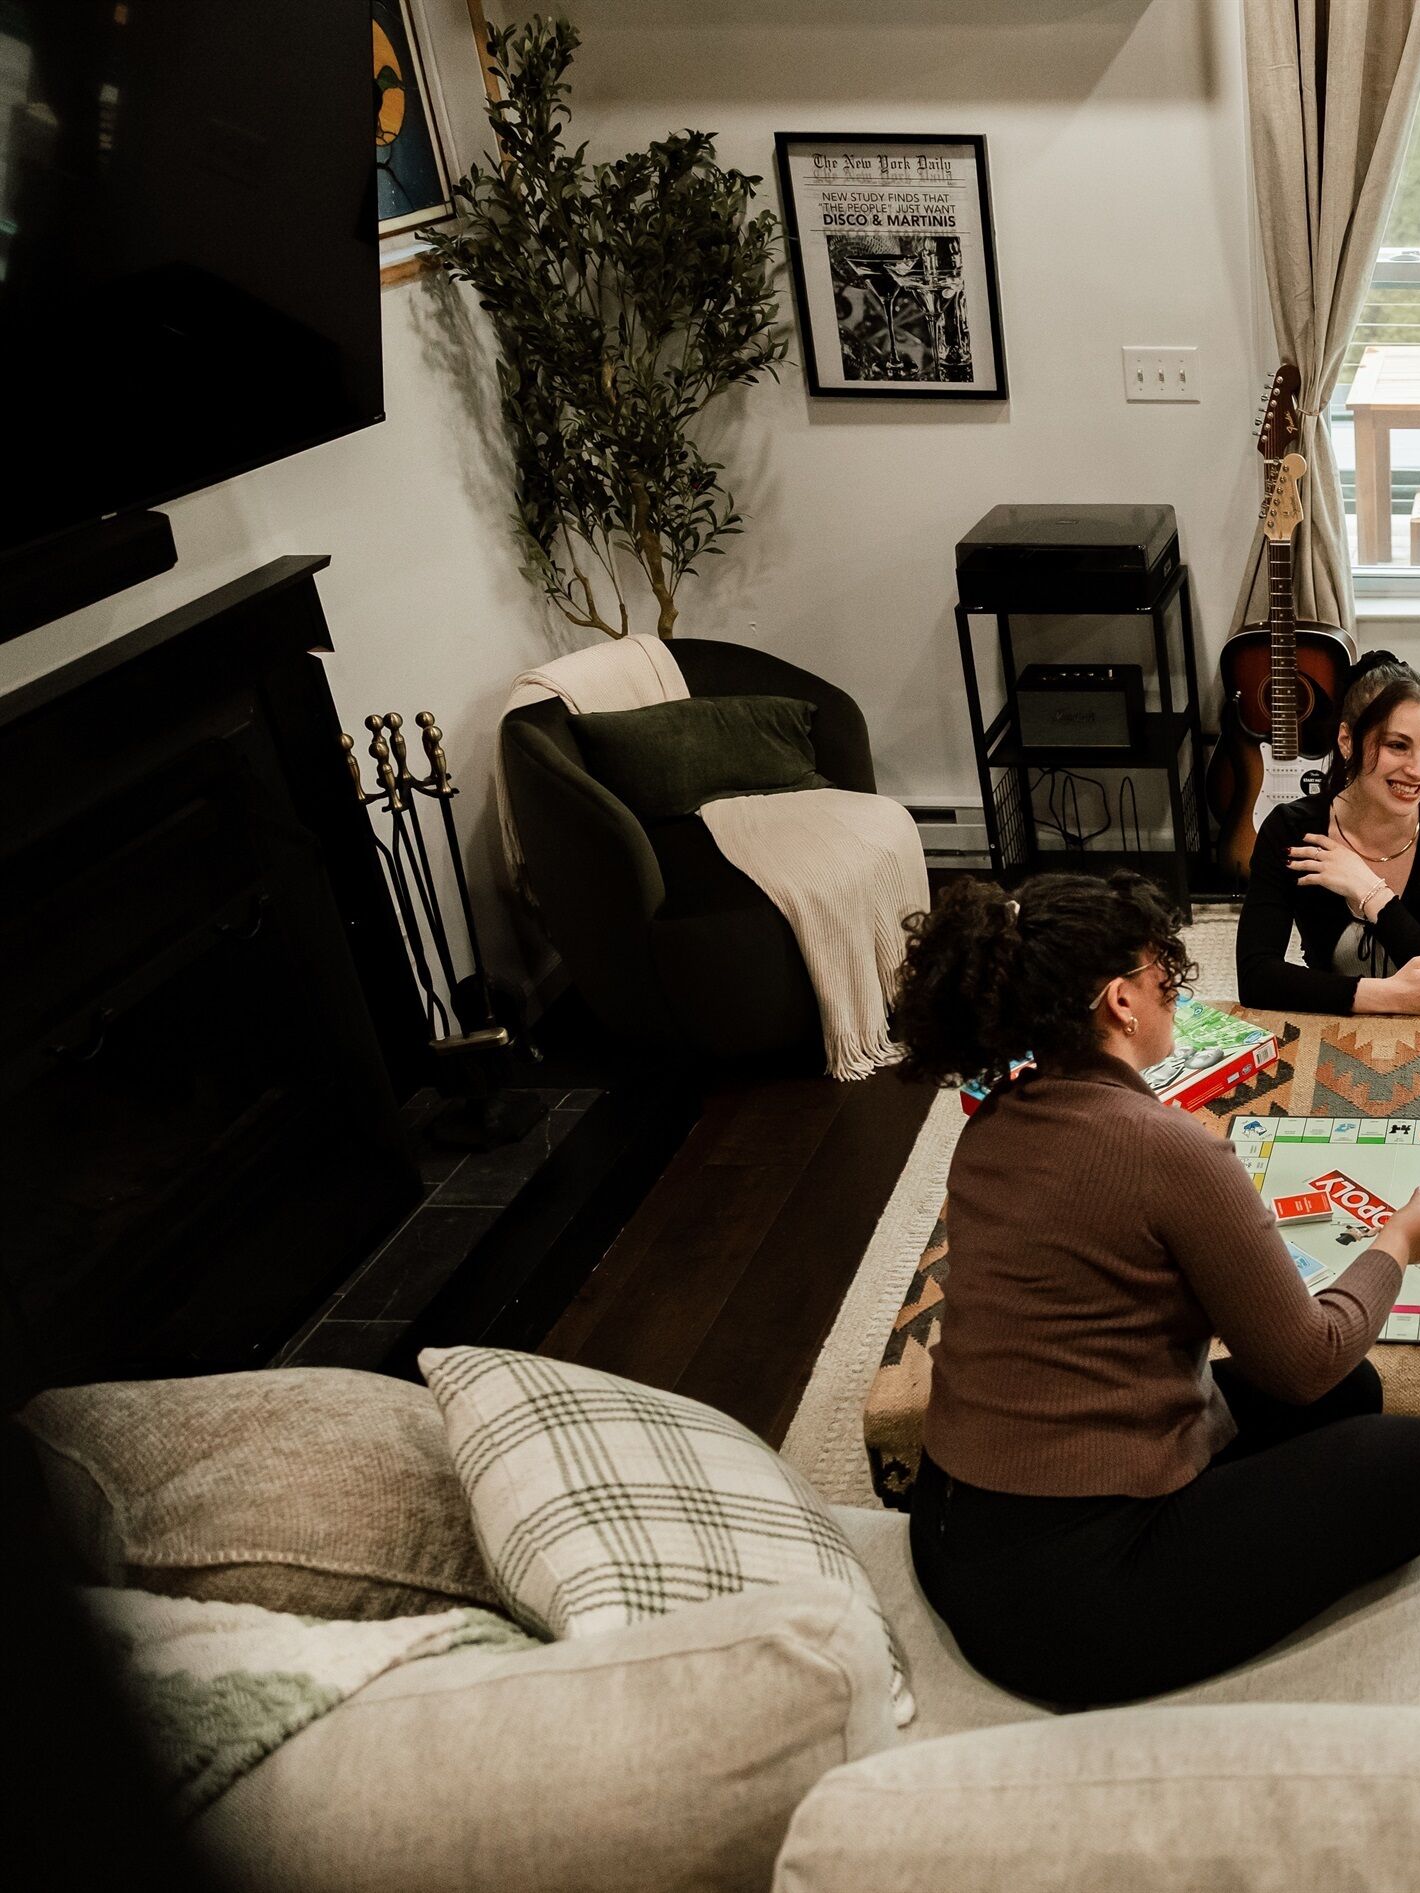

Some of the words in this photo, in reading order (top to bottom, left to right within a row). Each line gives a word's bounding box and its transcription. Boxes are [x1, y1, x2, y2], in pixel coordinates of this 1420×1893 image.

[813, 153, 838, 172] The
[842, 153, 871, 169] New
[877, 154, 911, 174] York
[915, 155, 951, 174] Daily
[822, 192, 847, 202] NEW
[850, 193, 885, 202] STUDY
[888, 193, 919, 203] FINDS
[922, 194, 949, 203] THAT
[896, 204, 920, 214] JUST
[923, 204, 955, 214] WANT
[823, 214, 868, 226] DISCO
[872, 215, 882, 226] &
[887, 215, 956, 227] MARTINIS
